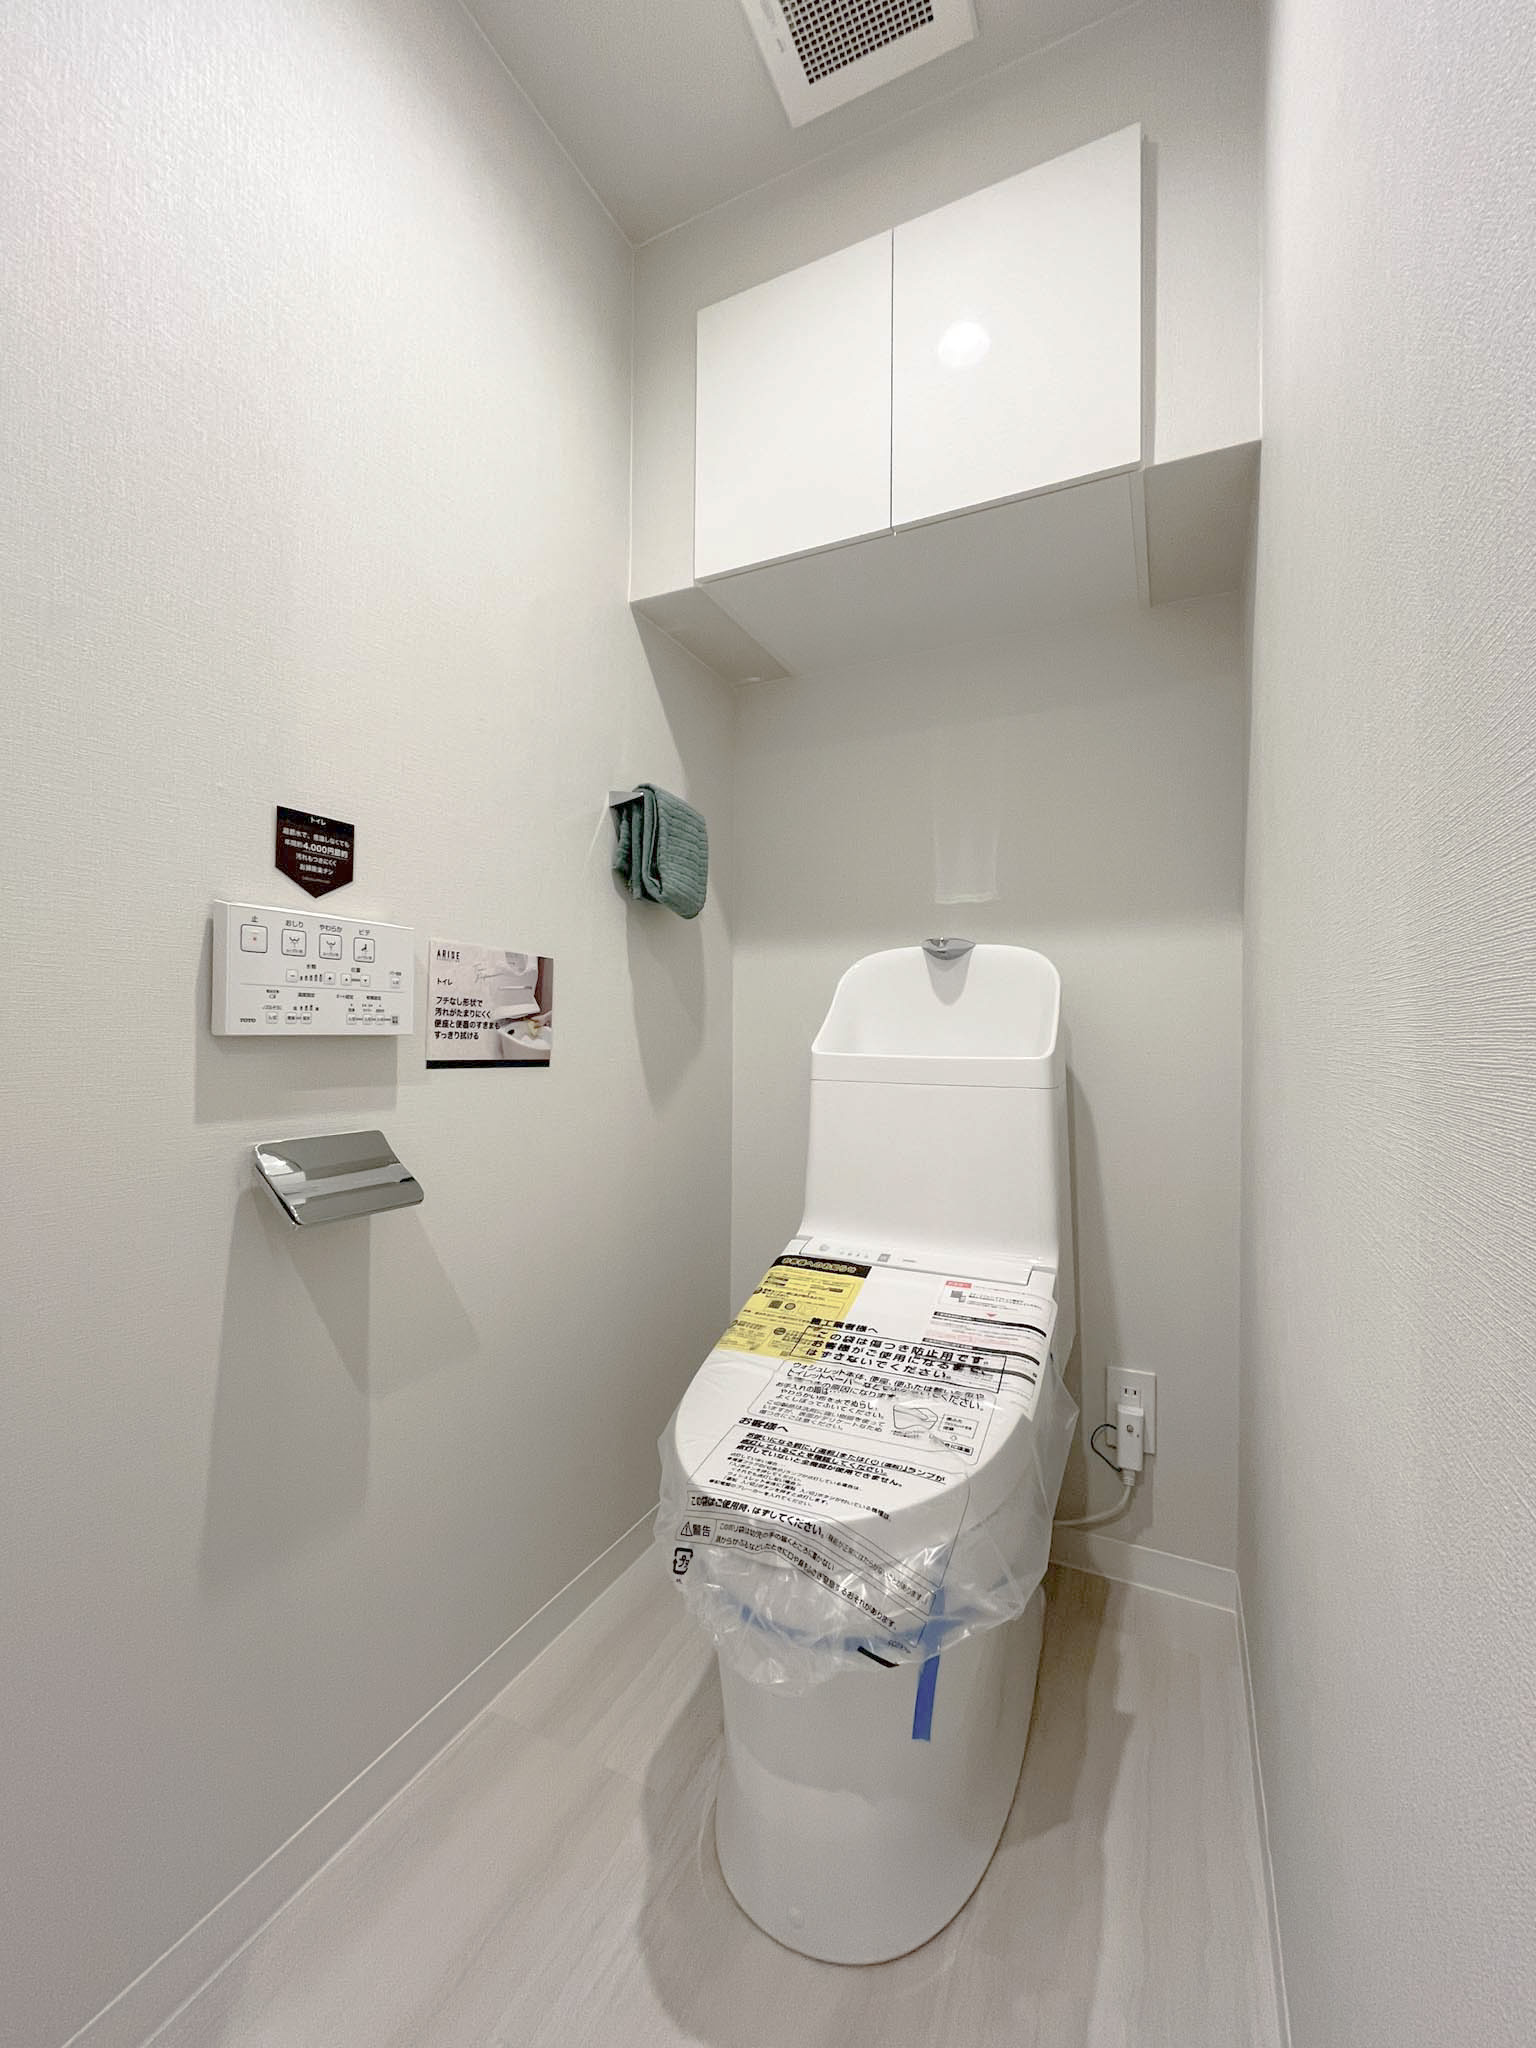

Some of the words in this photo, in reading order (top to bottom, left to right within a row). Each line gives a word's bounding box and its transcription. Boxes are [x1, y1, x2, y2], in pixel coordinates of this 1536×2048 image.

[310, 816, 326, 826] トイレ
[285, 920, 304, 929] おしり
[319, 924, 343, 934] やわらか
[437, 977, 453, 986] トイレ
[436, 996, 483, 1007] フチなし形状で
[434, 1007, 491, 1018] 汚れがたまりにくく
[434, 1019, 501, 1030] 便座と便器のすきまも
[434, 1031, 480, 1040] すっきり拭ける
[738, 1416, 789, 1433] お客様へ
[692, 1524, 711, 1537] 警告
